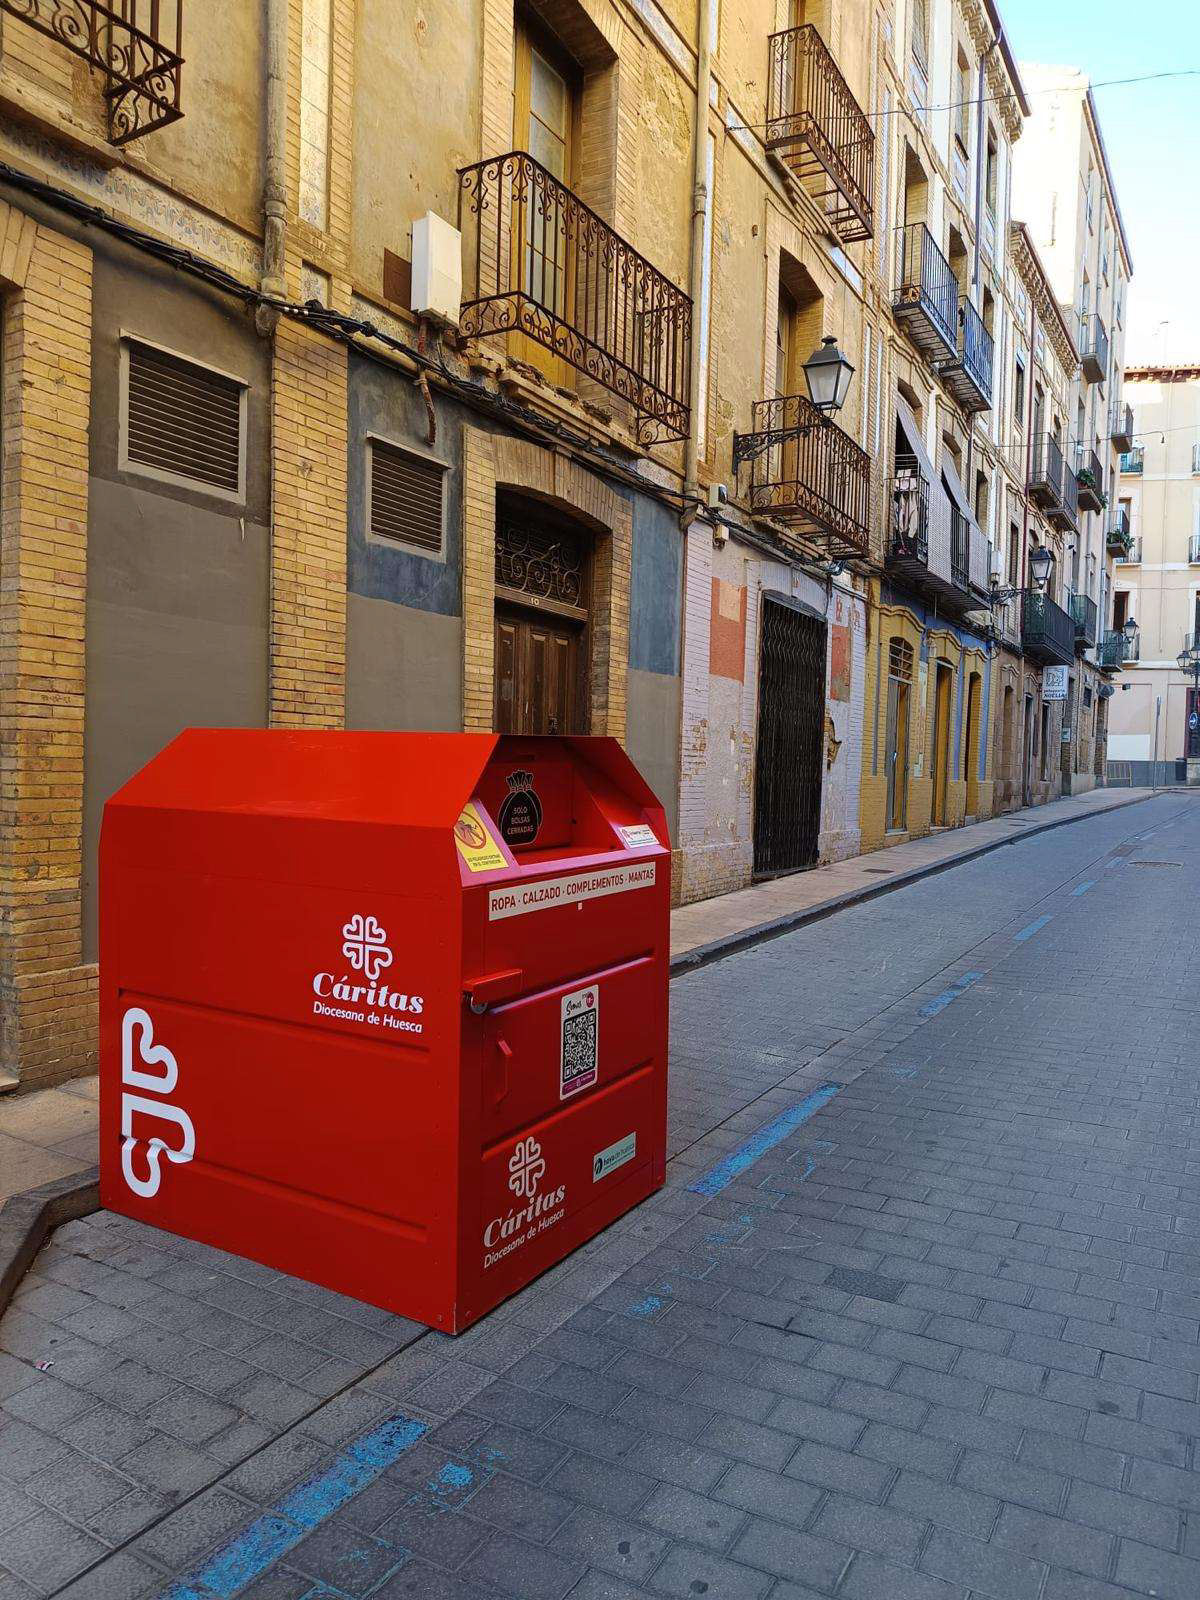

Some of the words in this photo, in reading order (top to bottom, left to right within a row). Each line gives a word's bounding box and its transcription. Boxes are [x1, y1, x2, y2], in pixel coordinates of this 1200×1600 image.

[531, 597, 540, 606] 10
[507, 825, 534, 835] CERRADAS
[511, 816, 530, 824] BOLSAS
[491, 897, 516, 912] ROPA
[522, 886, 561, 904] CALZADO
[566, 874, 625, 895] COMPLEMENTOS
[628, 869, 655, 882] MANTAS
[313, 972, 424, 1014] Cáritas
[313, 1001, 365, 1022] Diocesana
[367, 1012, 380, 1025] de
[383, 1014, 423, 1033] Huesca
[484, 1185, 566, 1248] Cáritas
[484, 1234, 525, 1269] Diocesana
[527, 1227, 536, 1239] de
[538, 1208, 565, 1233] Huesca
